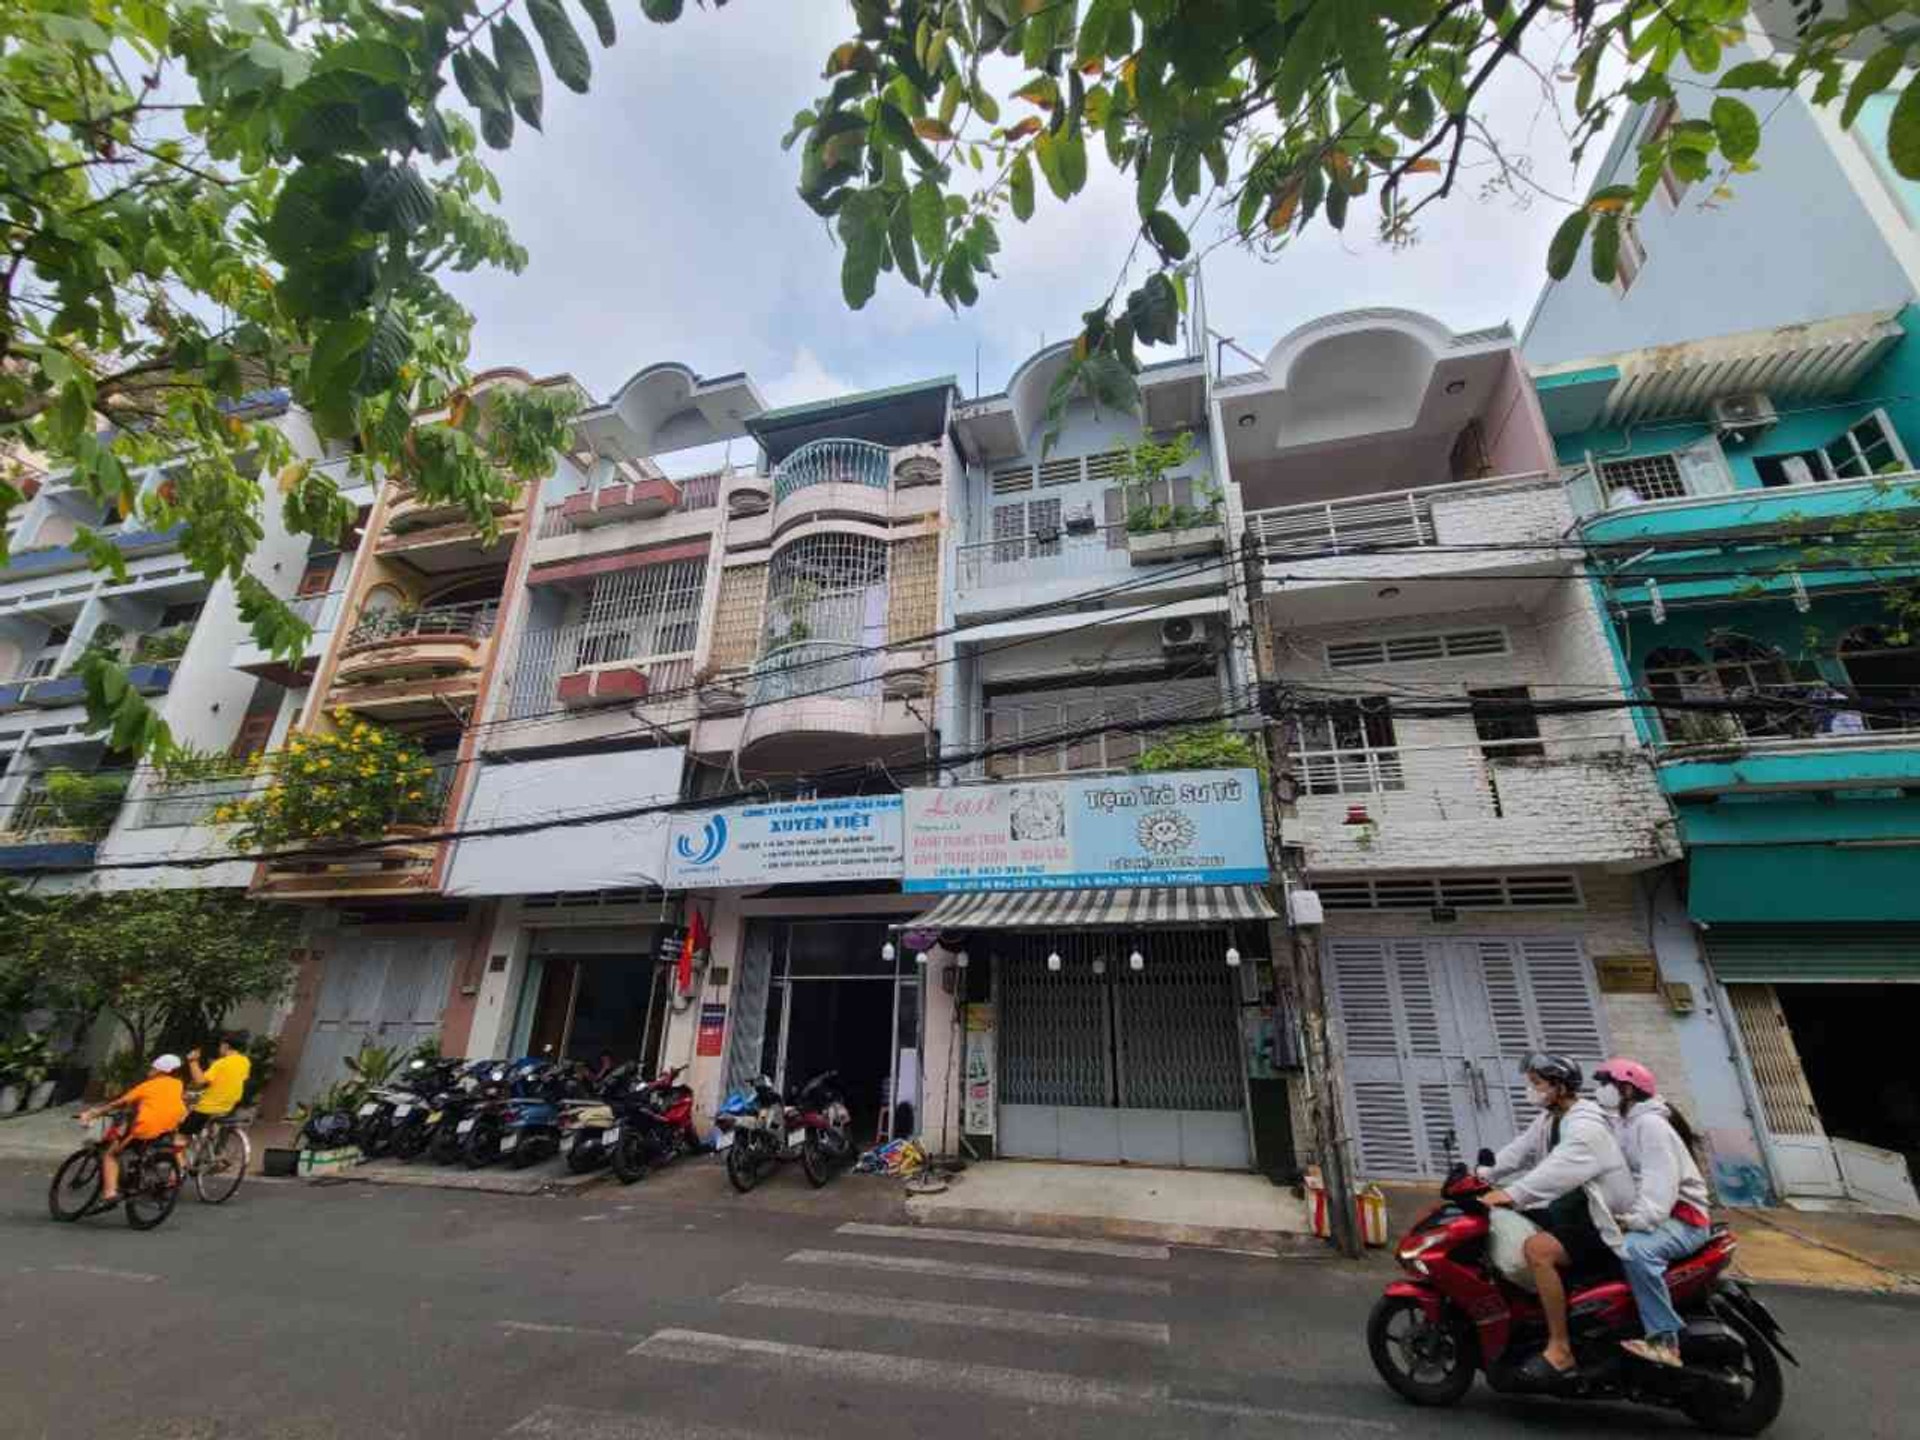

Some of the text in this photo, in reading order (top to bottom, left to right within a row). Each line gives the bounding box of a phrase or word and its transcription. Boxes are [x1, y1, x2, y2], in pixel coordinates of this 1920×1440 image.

[1085, 778, 1241, 814] Tiệm Trà Sư Tử
[769, 811, 871, 833] XUYÊN VIỆT
